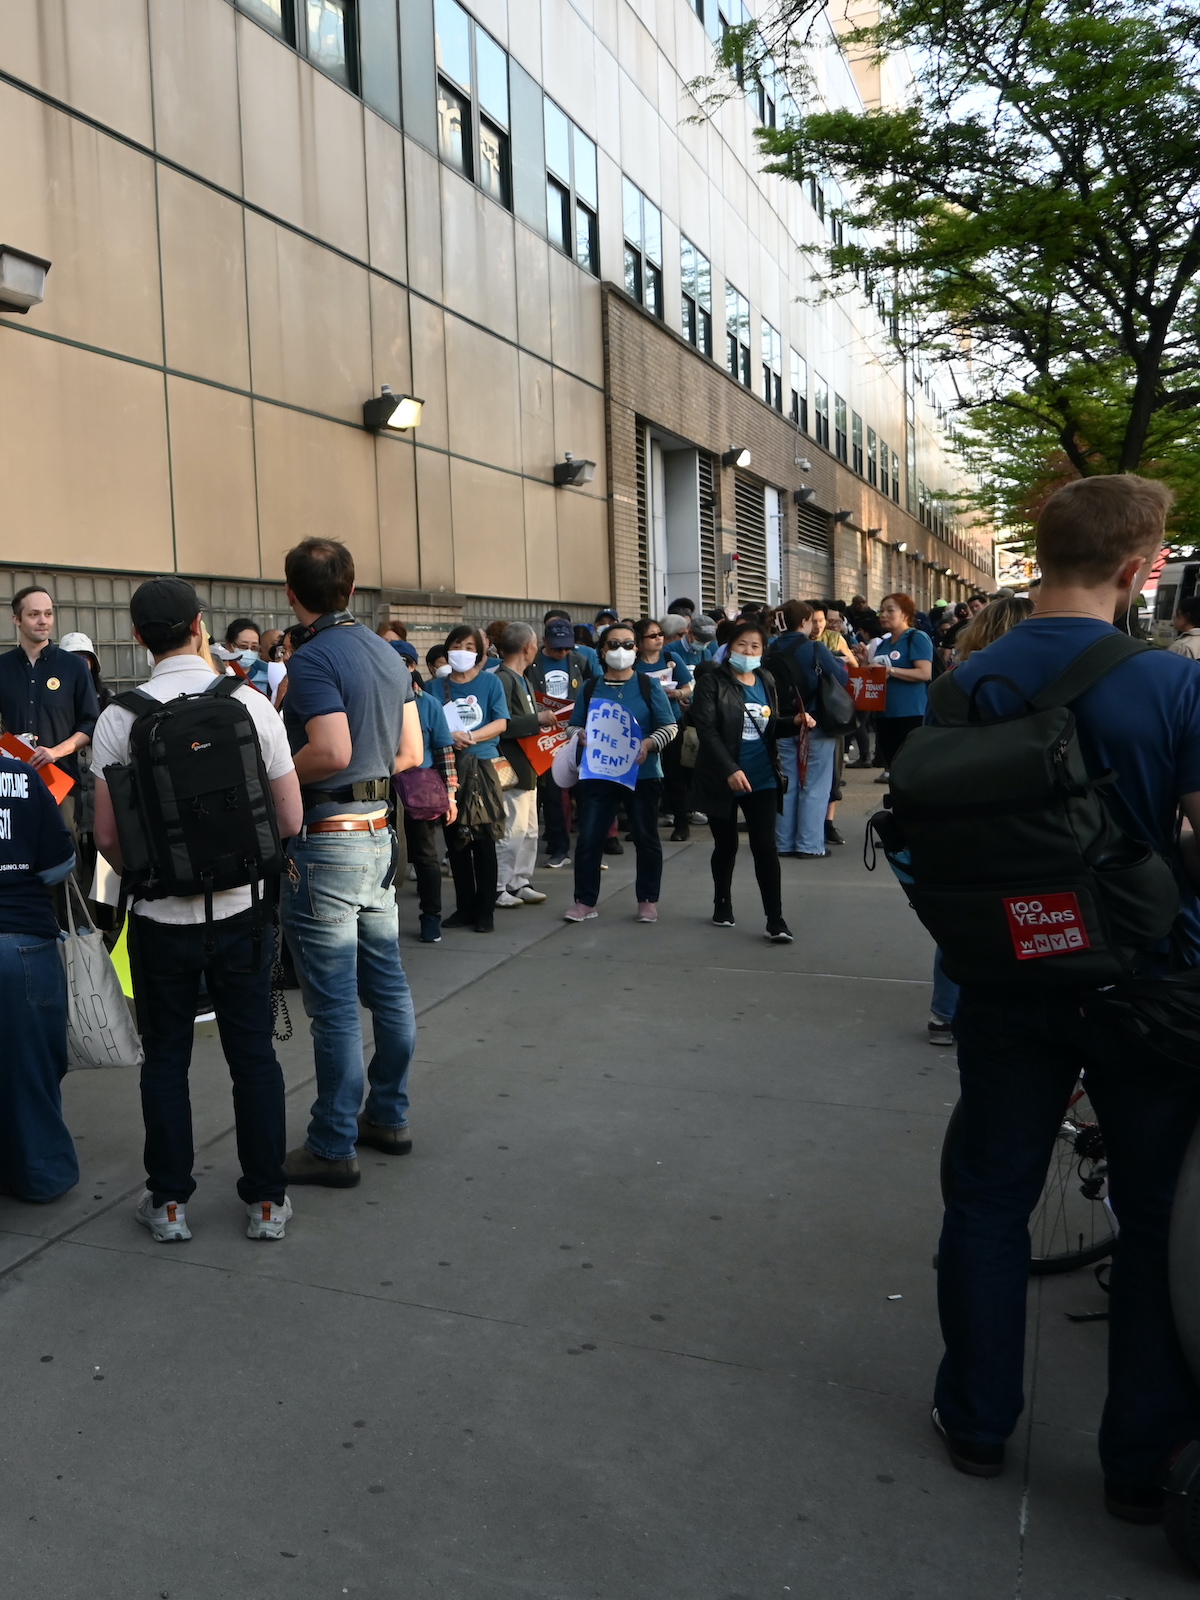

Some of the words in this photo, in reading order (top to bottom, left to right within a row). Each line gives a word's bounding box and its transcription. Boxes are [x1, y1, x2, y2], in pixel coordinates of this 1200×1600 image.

[592, 728, 618, 749] THE
[592, 748, 630, 767] RENT!
[1010, 901, 1043, 915] 100
[1014, 910, 1076, 926] YEARS
[1020, 933, 1080, 951] WNYC
[67, 1028, 122, 1066] ACH
